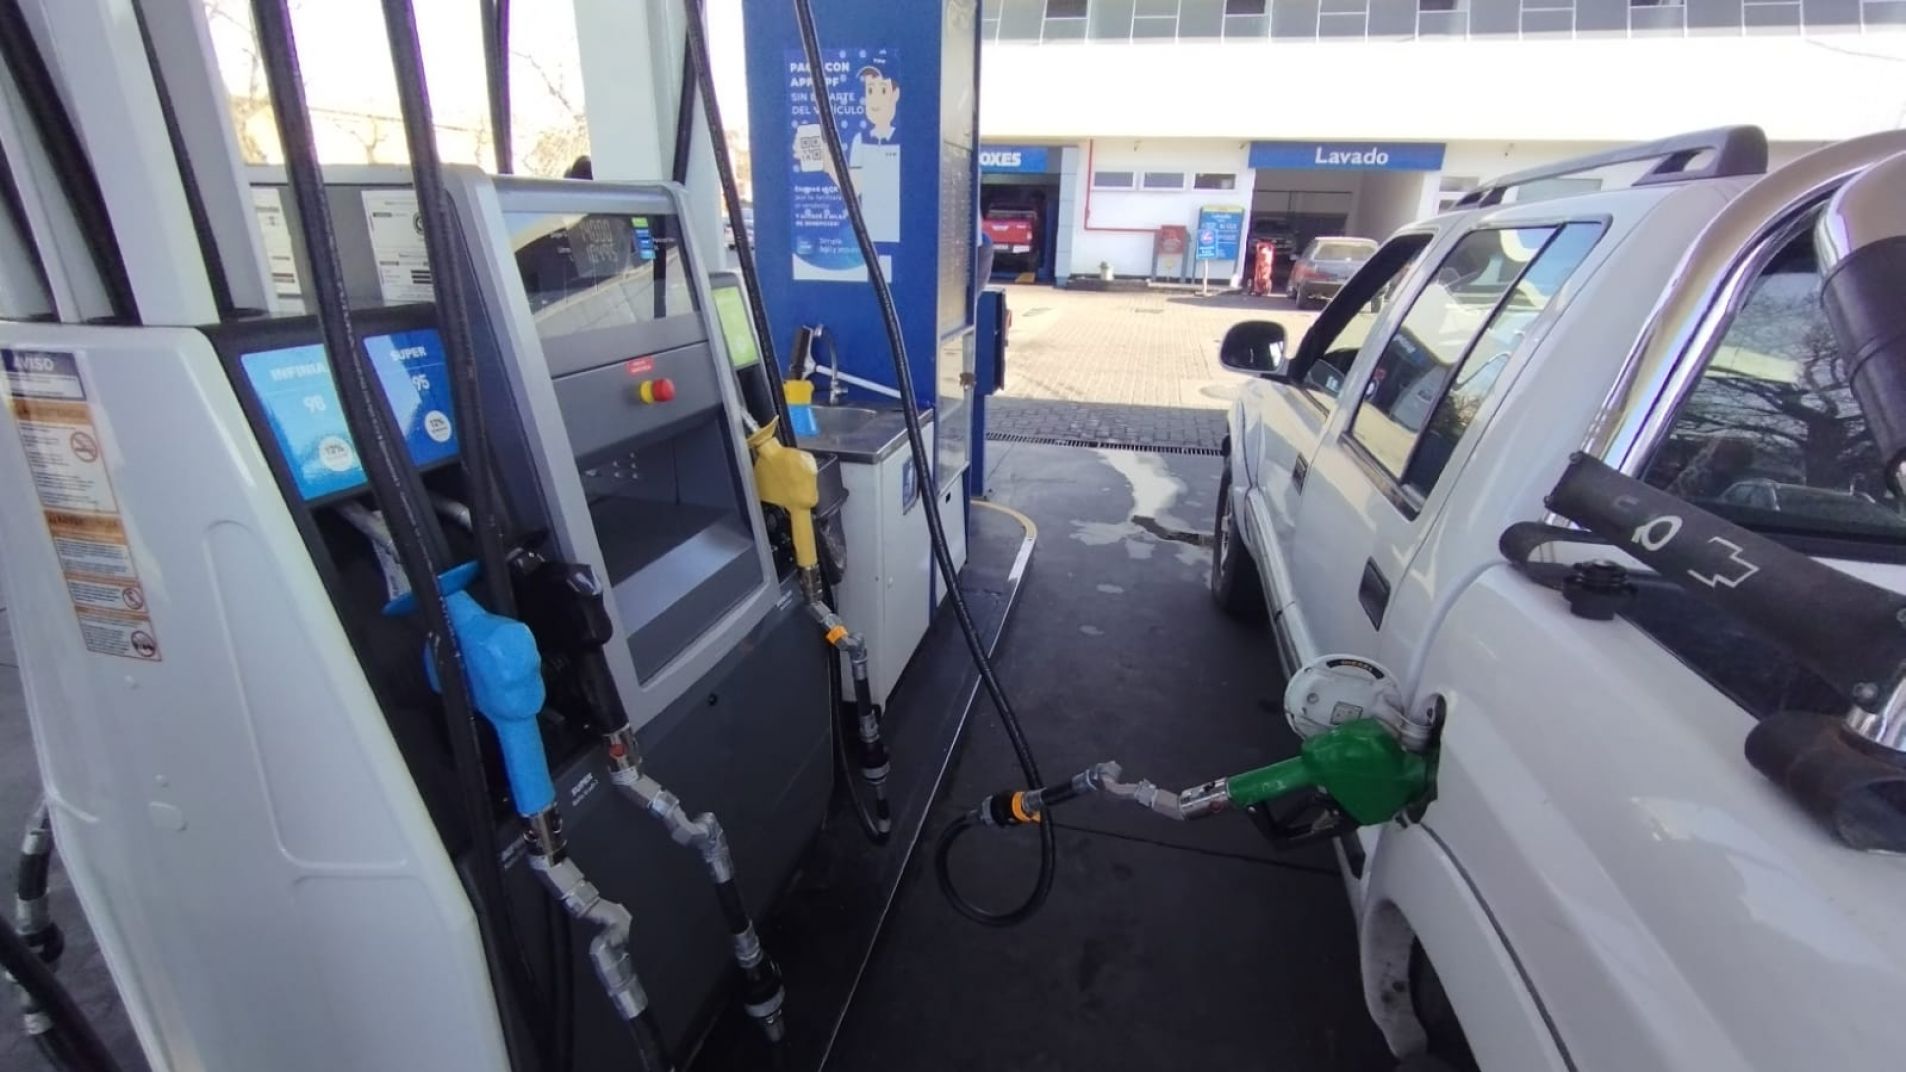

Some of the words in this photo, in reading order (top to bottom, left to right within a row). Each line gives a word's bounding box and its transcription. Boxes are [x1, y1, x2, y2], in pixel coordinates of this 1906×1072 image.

[825, 62, 850, 73] CON
[791, 92, 808, 102] SIN
[792, 106, 811, 115] DEL
[979, 152, 1022, 167] OXES
[1315, 147, 1389, 165] Lavado
[391, 346, 427, 361] SUPER
[14, 356, 54, 371] AVISO
[270, 362, 328, 381] INFINIA
[412, 374, 430, 391] 95
[303, 395, 326, 413] 98
